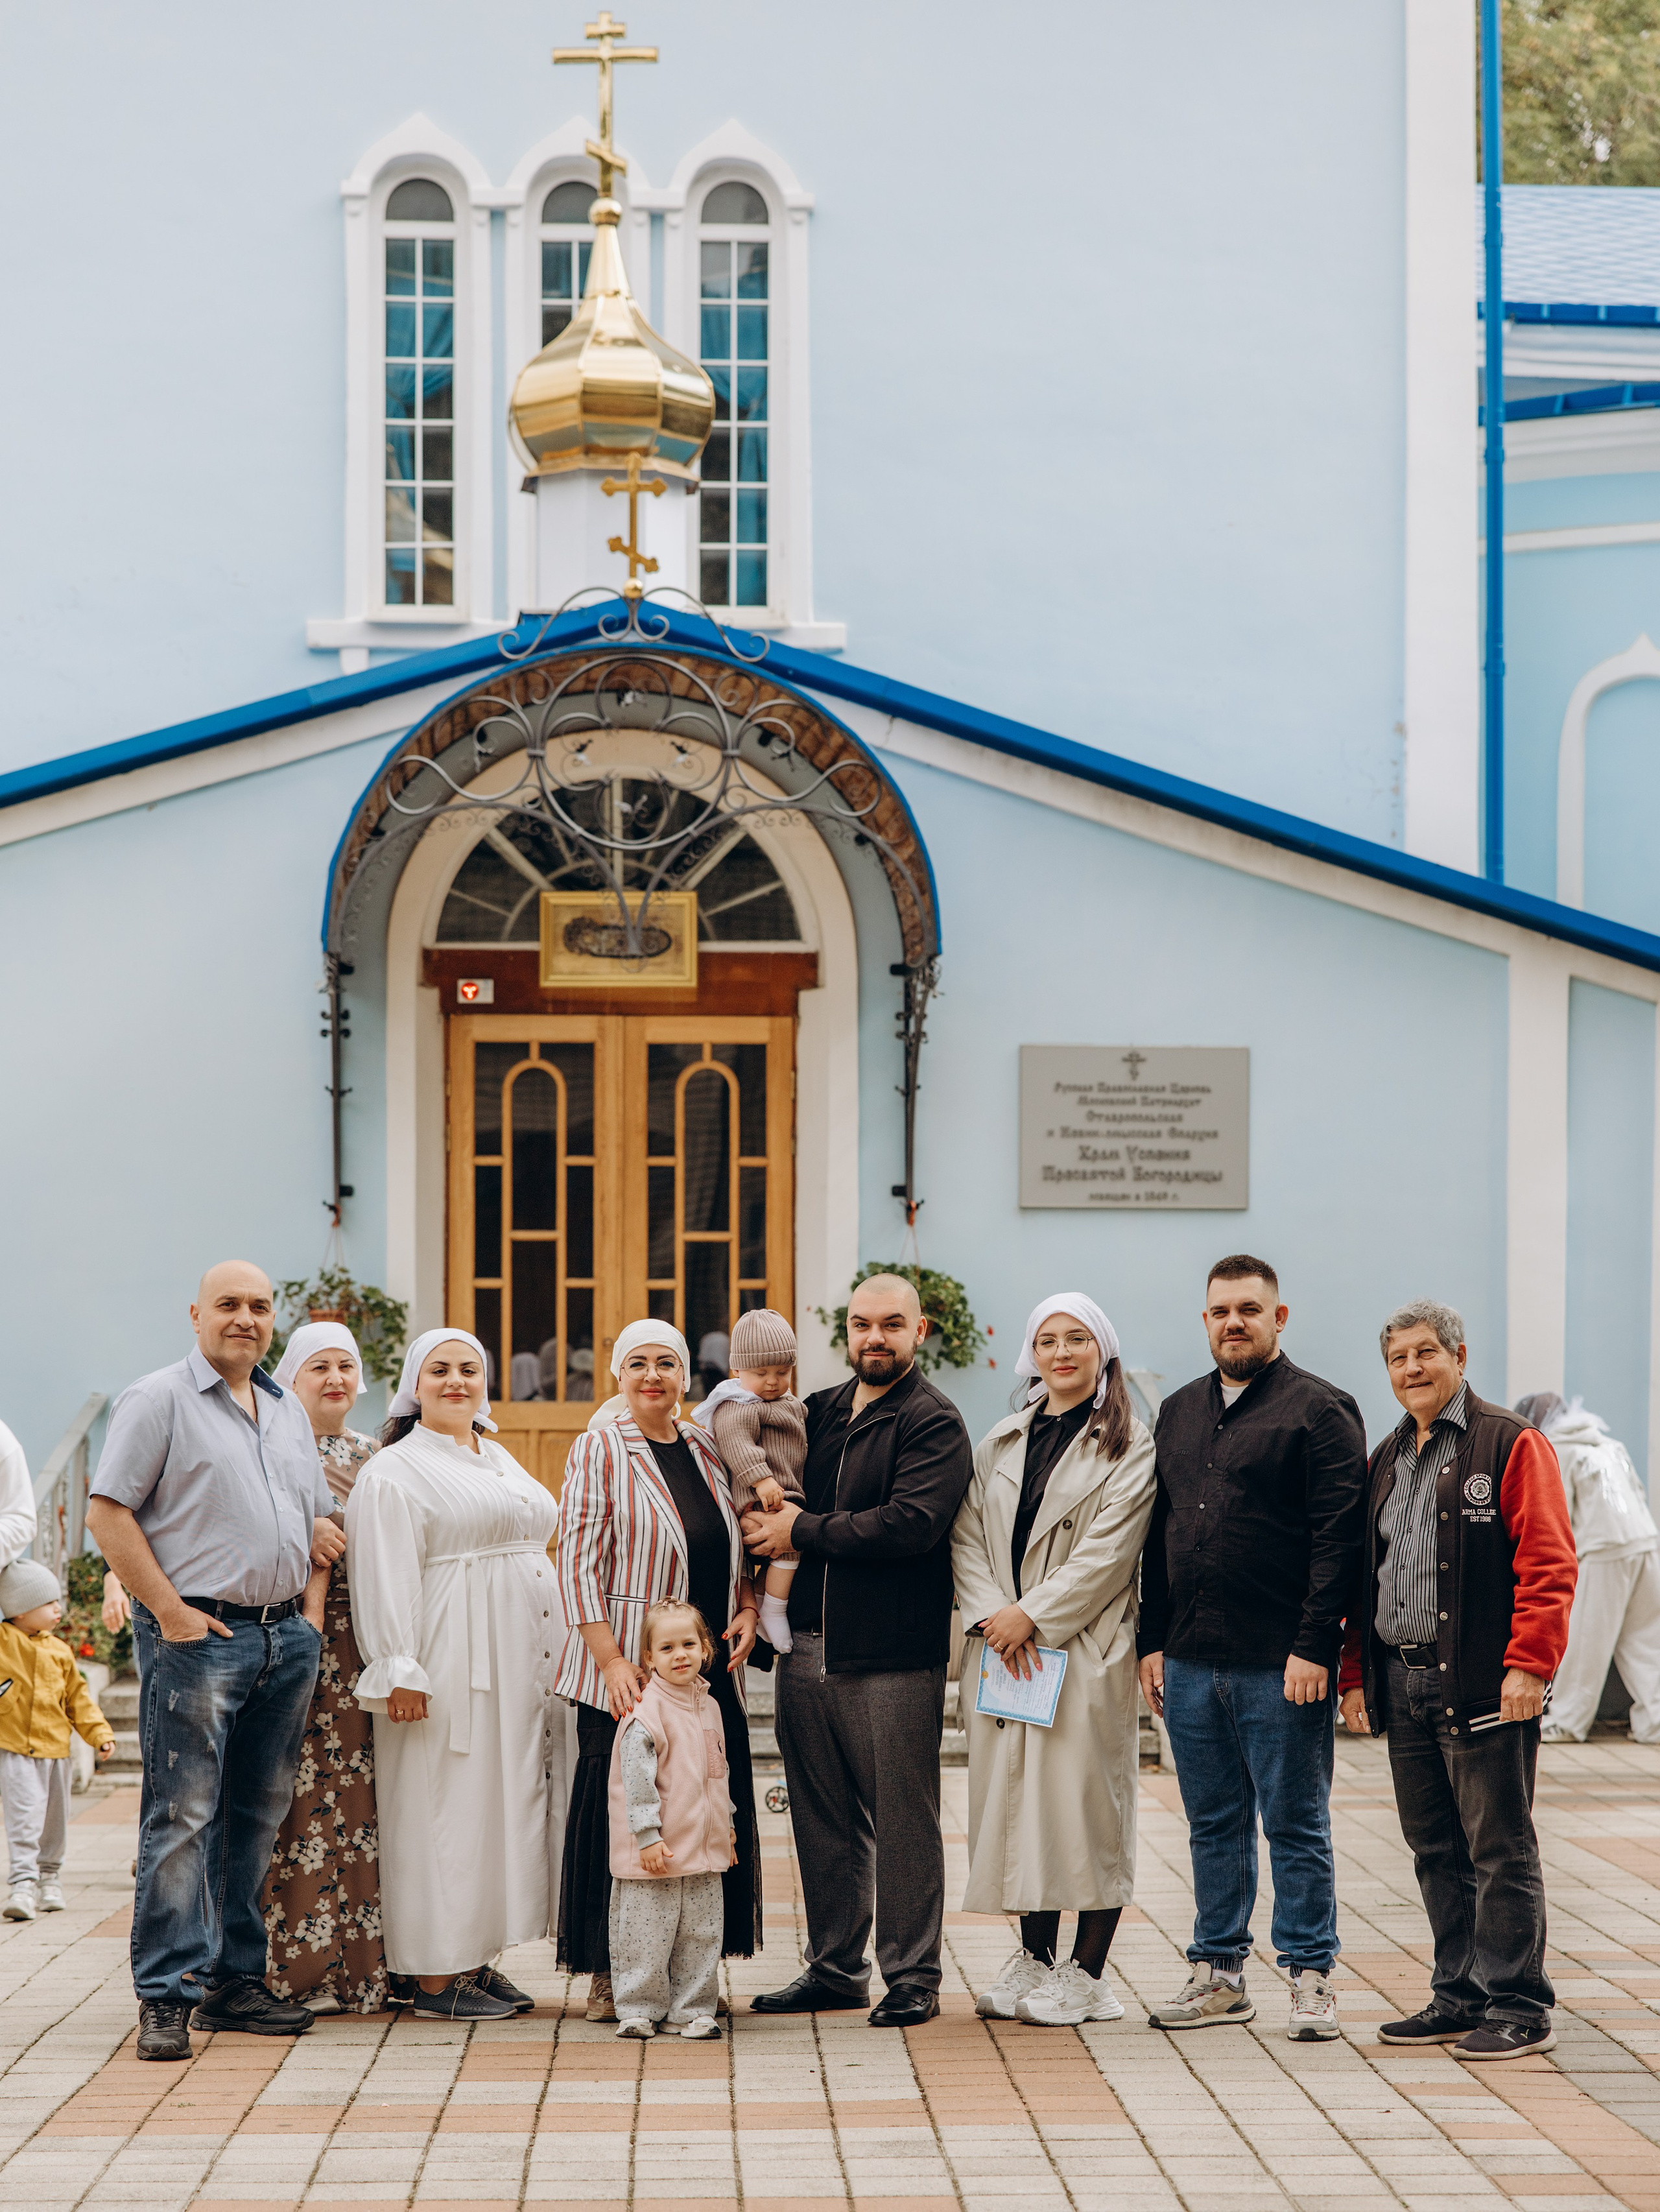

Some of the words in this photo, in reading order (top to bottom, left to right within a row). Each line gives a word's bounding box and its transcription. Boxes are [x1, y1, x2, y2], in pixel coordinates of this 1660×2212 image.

[1086, 1110, 1183, 1123] Ставропольская
[1079, 1145, 1120, 1162] Храм
[1133, 1166, 1223, 1183] Богородицы
[1465, 1476, 1475, 1490] COLLEGE
